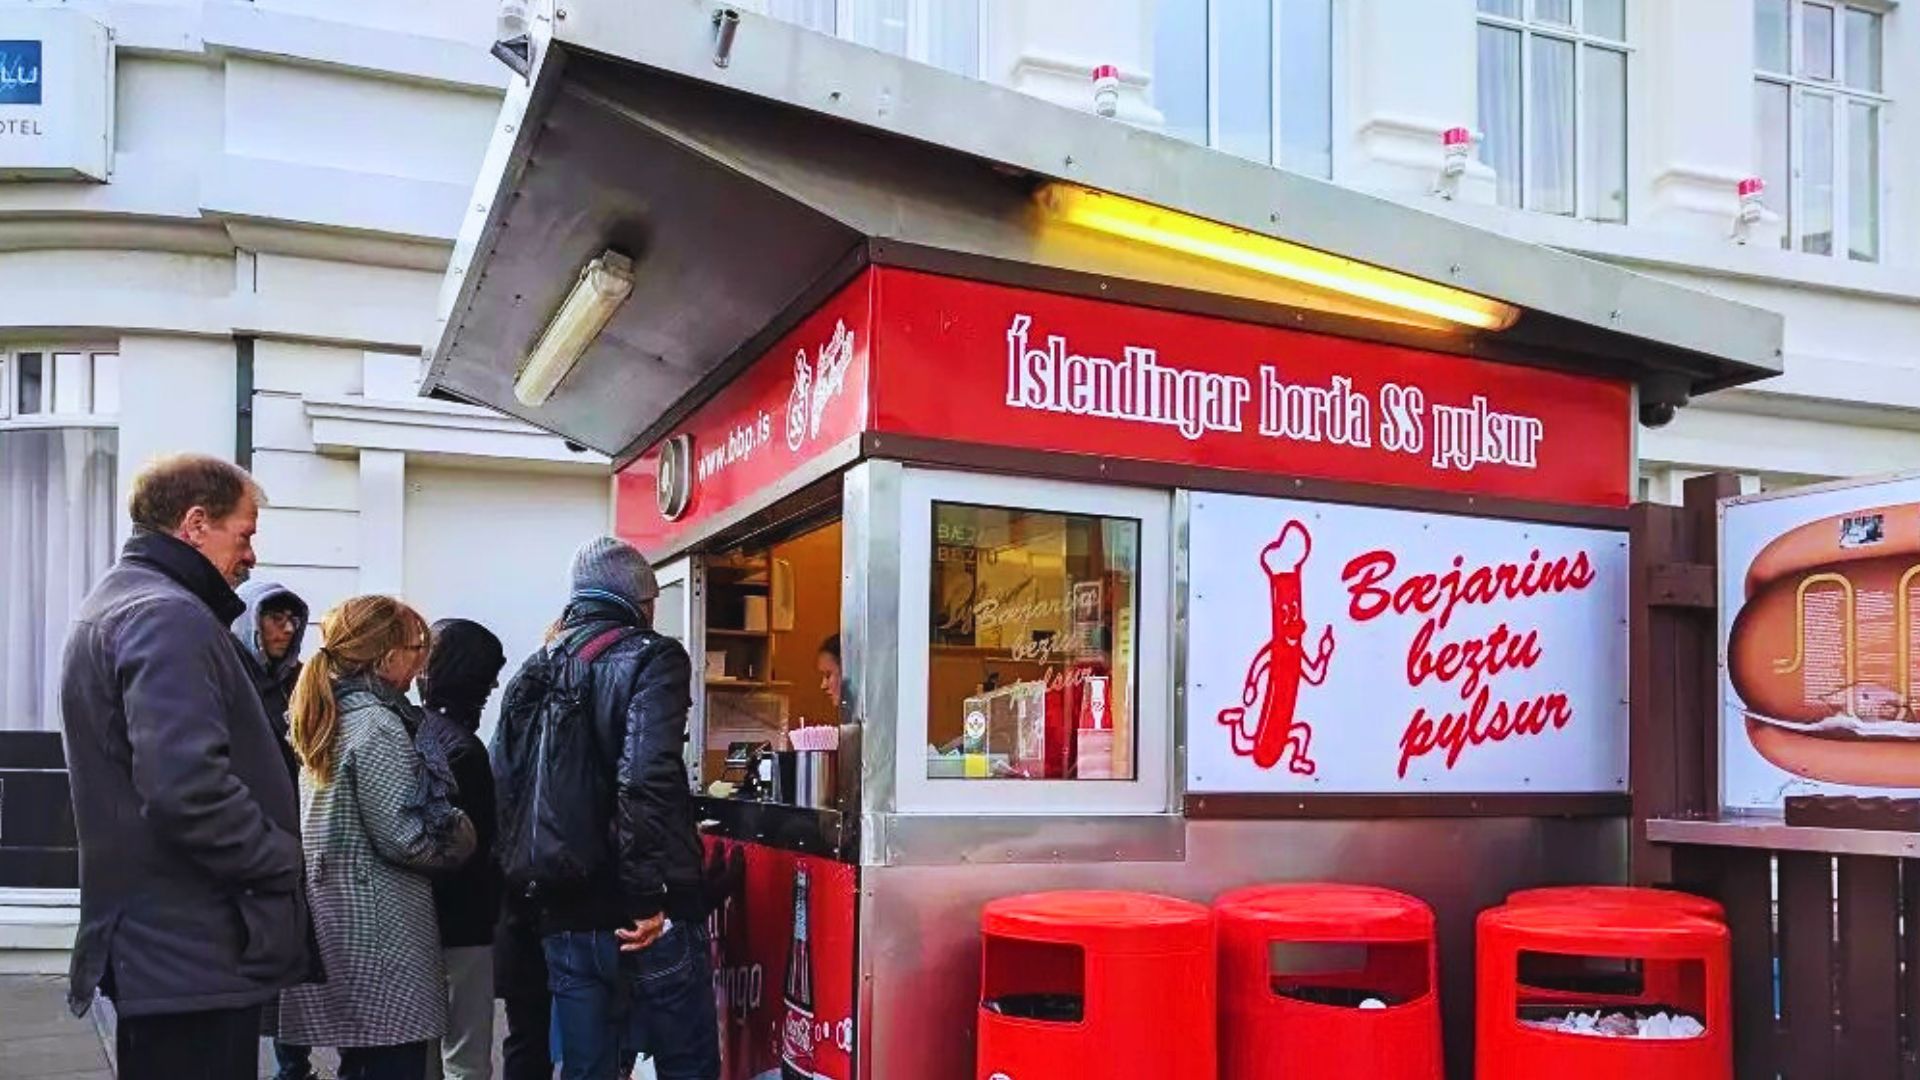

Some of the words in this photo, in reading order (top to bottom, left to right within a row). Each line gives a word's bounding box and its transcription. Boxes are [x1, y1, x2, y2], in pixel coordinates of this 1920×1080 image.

[1006, 314, 1250, 441] Íslendingar
[1259, 366, 1371, 448] borða
[1380, 382, 1424, 454] SS
[1432, 396, 1543, 471] pylsur
[697, 409, 770, 483] www.bbp.is
[1341, 549, 1596, 629] Bæjarins
[1407, 618, 1542, 699] beztu
[1398, 685, 1572, 779] pylsur
